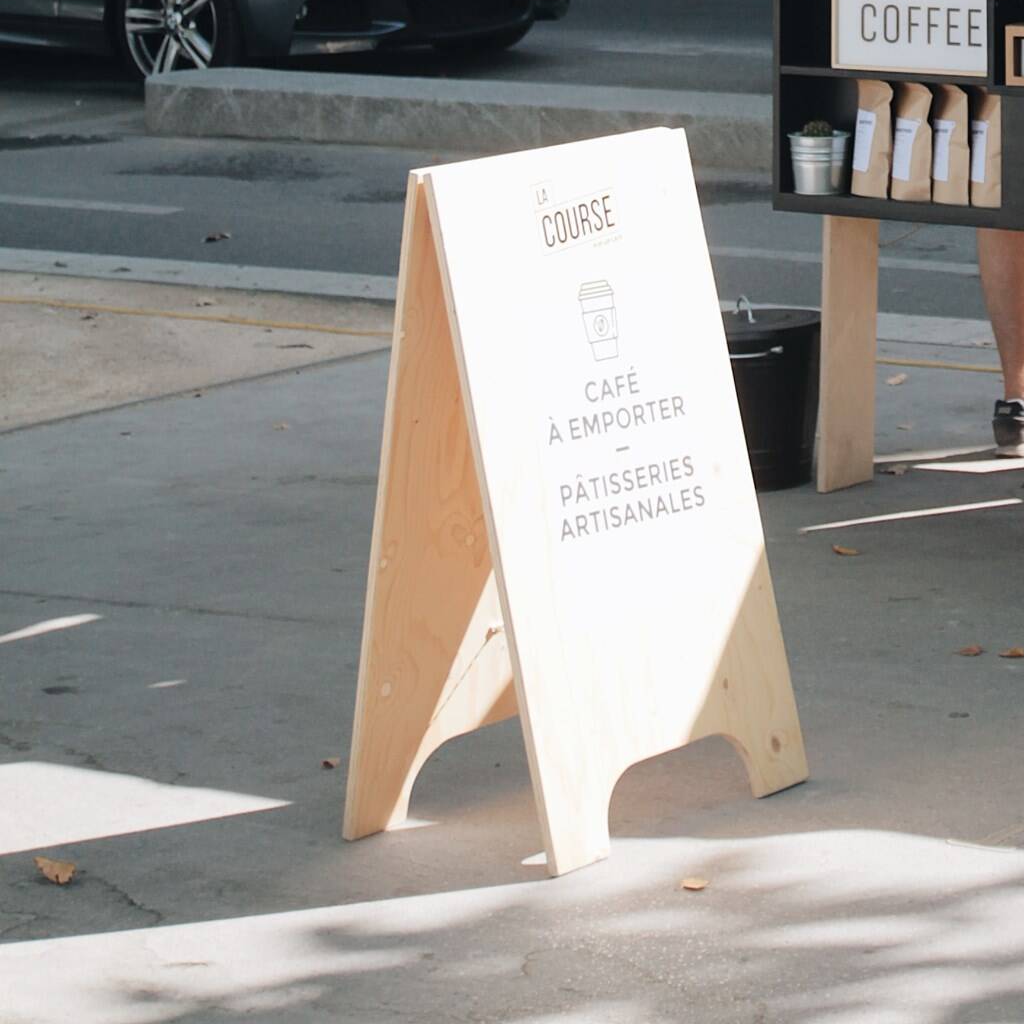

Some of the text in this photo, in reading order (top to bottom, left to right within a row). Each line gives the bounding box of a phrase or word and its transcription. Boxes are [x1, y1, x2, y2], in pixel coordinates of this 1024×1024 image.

[860, 3, 983, 48] COFFEE
[536, 188, 548, 206] LA
[541, 195, 615, 248] COURSE
[584, 367, 640, 403] CAFÉ
[548, 395, 686, 445] À EMPORTER
[559, 456, 695, 508] PÂTISSERIES
[560, 485, 706, 541] ARTISANALES
